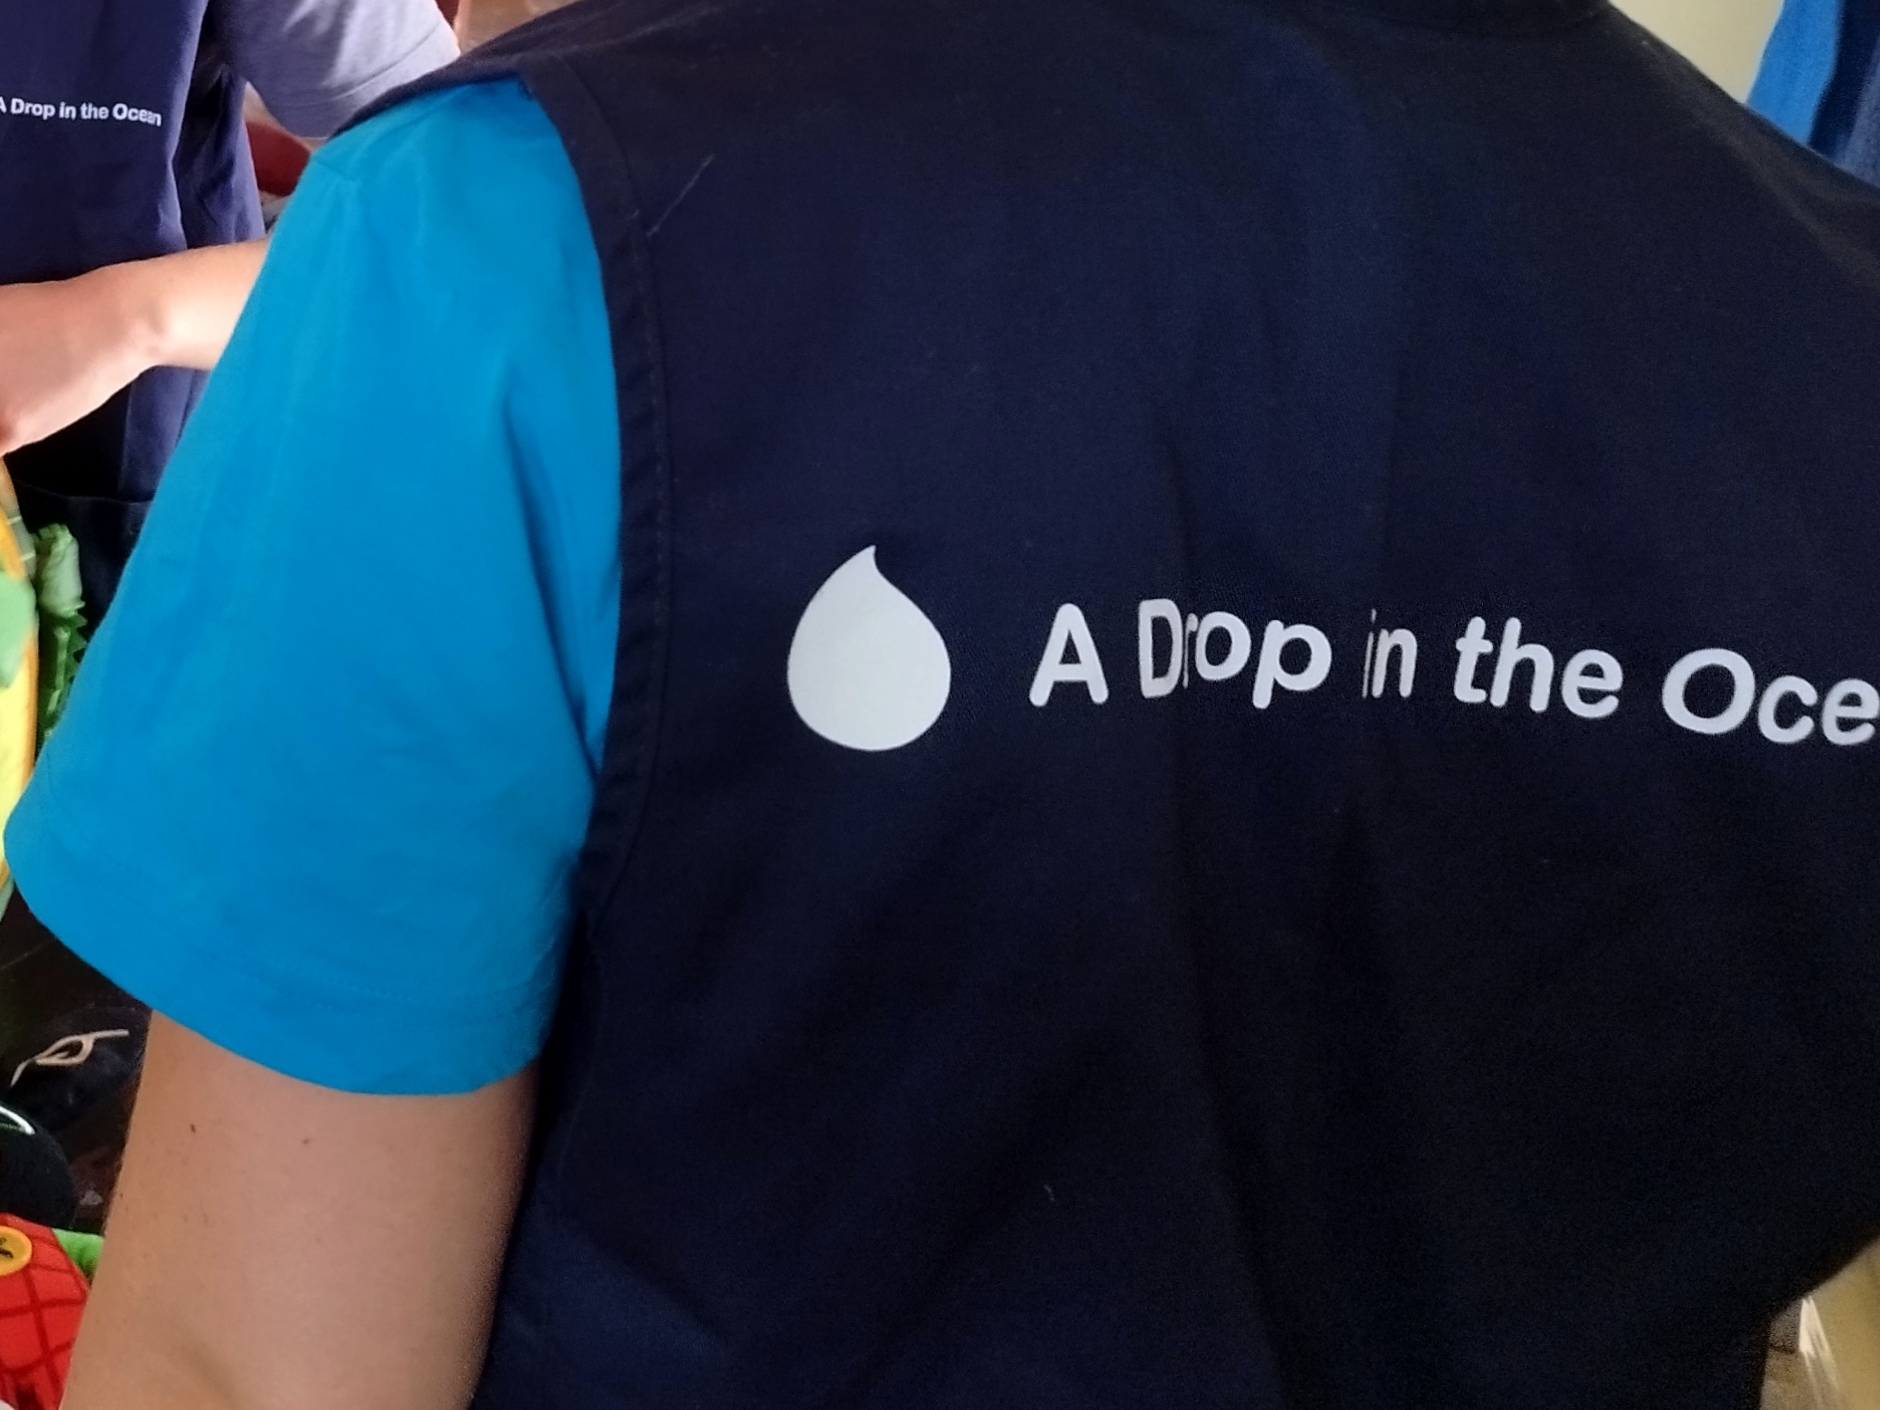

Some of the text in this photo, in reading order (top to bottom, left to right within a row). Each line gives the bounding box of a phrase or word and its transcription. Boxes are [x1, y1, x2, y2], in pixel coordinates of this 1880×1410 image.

[11, 98, 55, 120] Drop
[59, 101, 77, 120] in
[80, 102, 109, 120] the
[112, 103, 161, 127] Ocean
[1028, 597, 1880, 747] A Drop in the Oce
